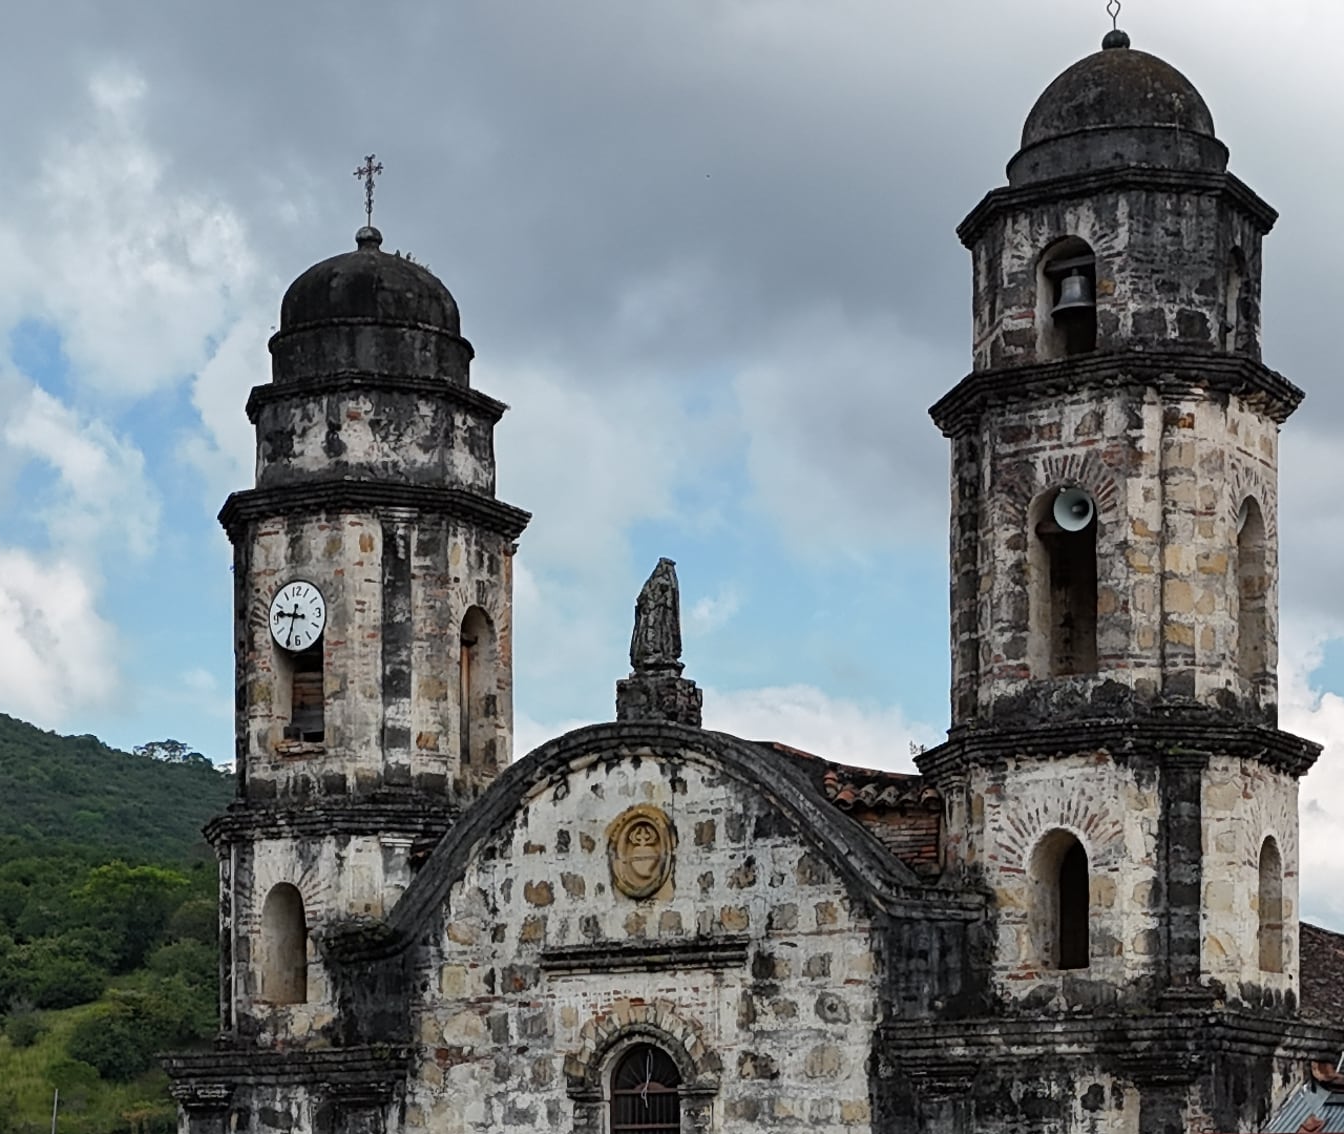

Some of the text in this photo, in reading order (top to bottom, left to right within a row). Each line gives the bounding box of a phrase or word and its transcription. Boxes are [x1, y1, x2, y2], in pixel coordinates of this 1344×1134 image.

[292, 586, 302, 598] 12
[315, 607, 322, 618] 3
[294, 635, 301, 646] 6
